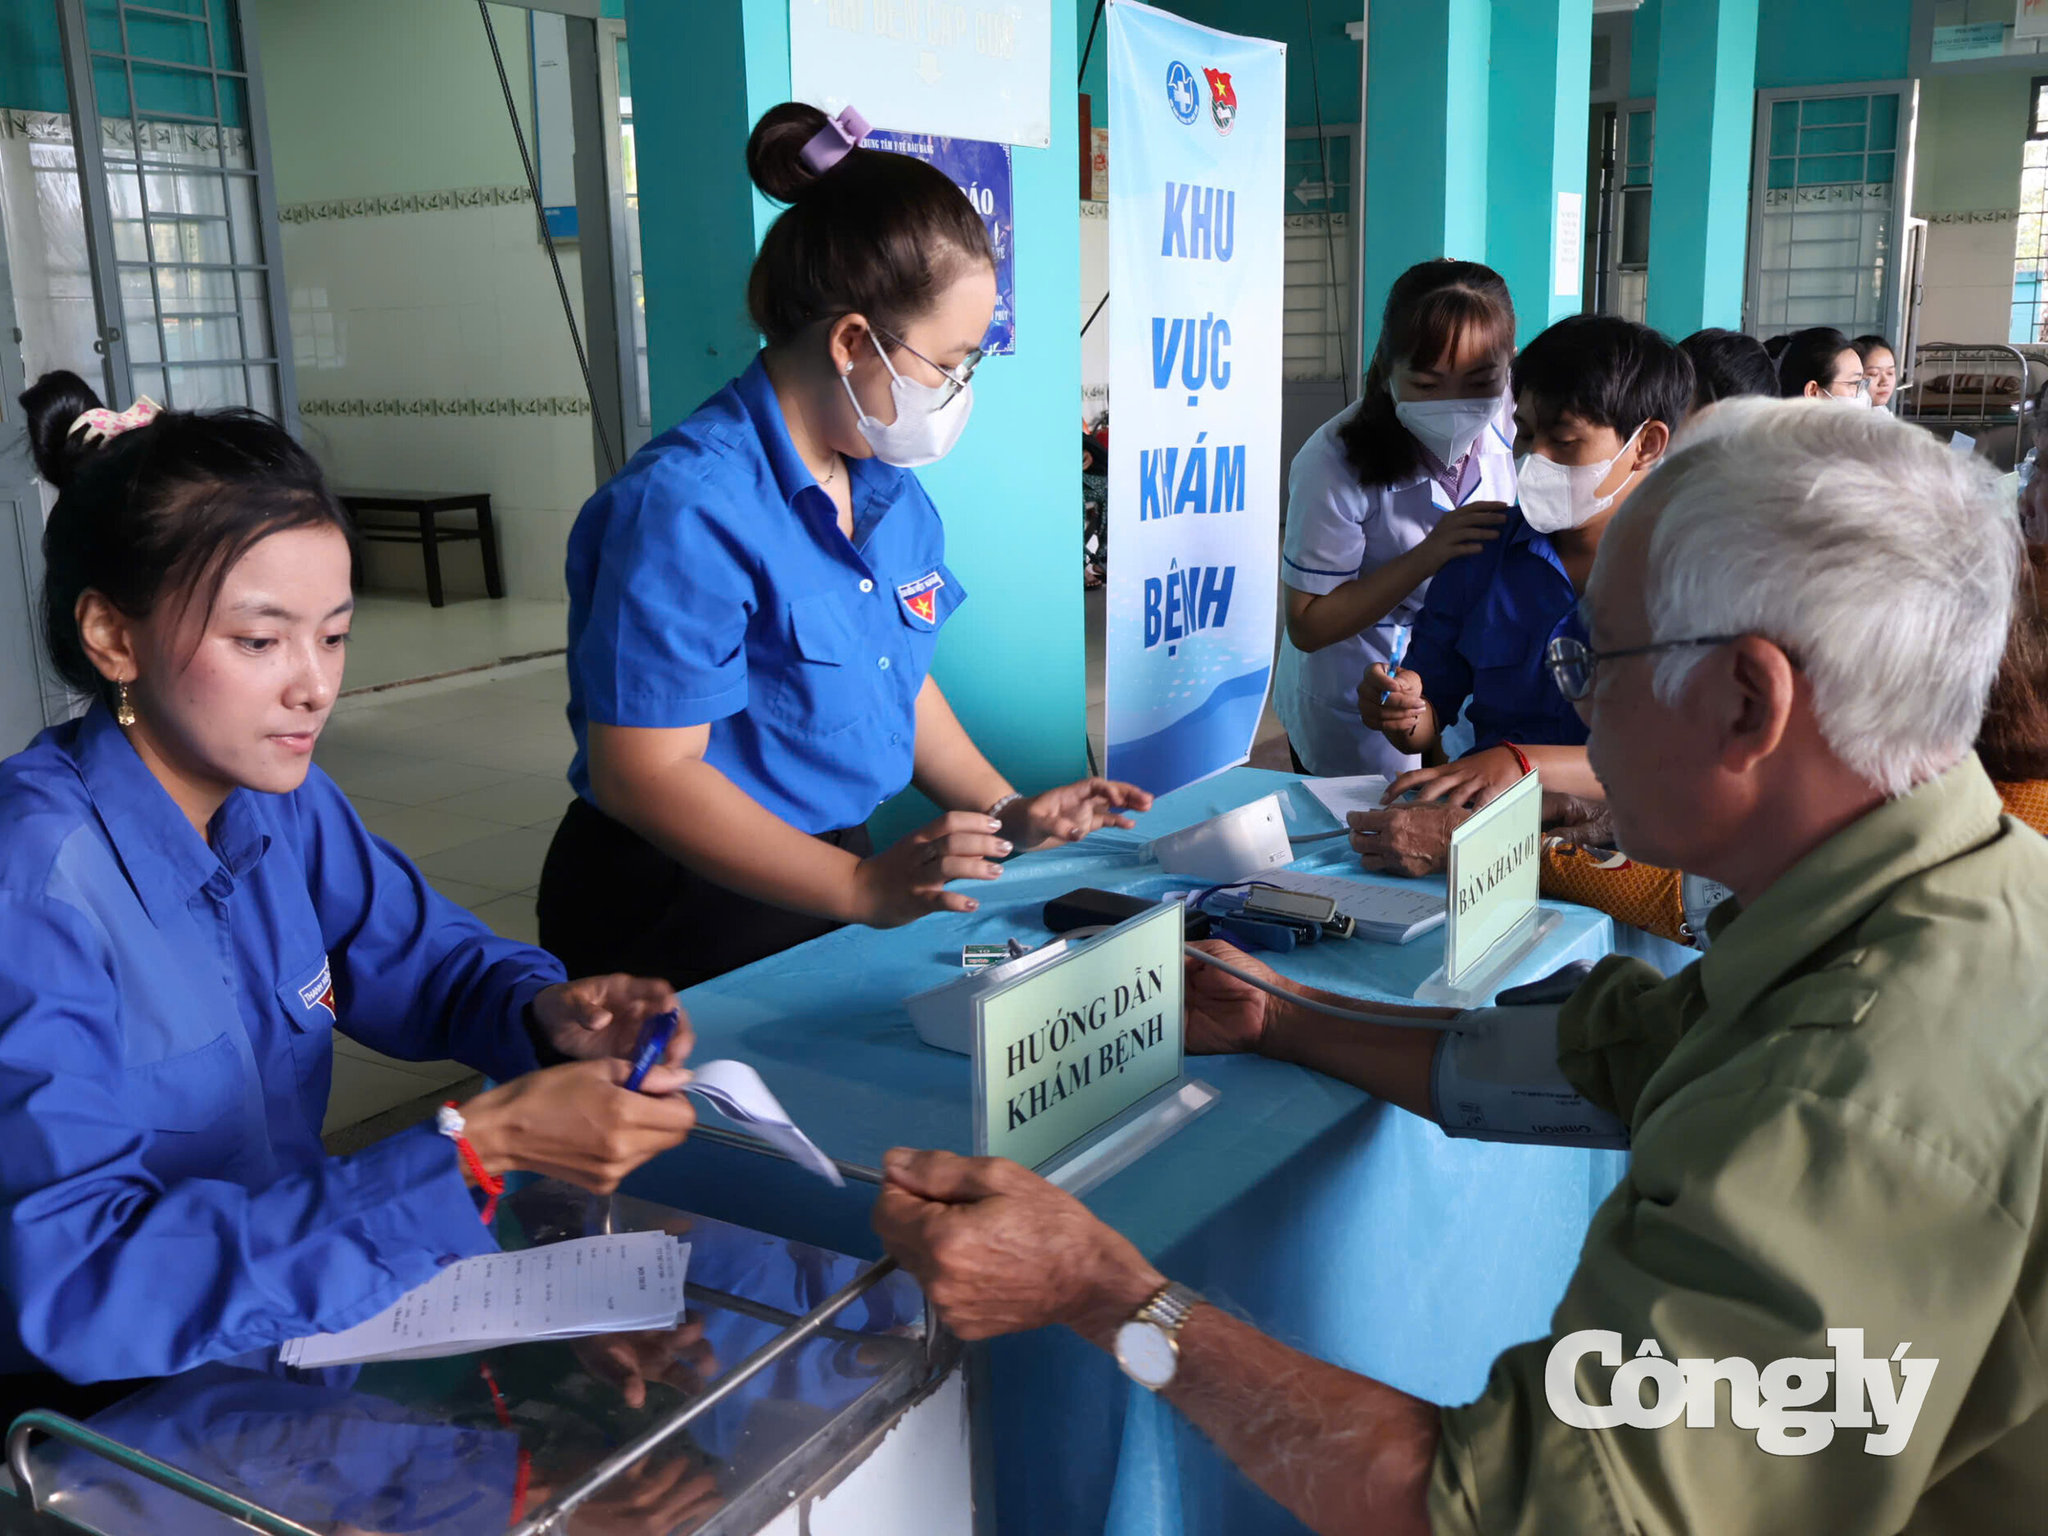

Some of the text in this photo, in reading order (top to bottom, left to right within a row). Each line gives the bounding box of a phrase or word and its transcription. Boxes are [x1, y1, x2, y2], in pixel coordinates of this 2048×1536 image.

[959, 181, 994, 215] ÁO
[1161, 181, 1235, 262] KHU
[1152, 312, 1231, 407] VỰC
[1140, 432, 1246, 522] KHÁM
[1144, 557, 1236, 657] BỆNH
[1487, 842, 1522, 893] KHÁM
[1525, 832, 1535, 860] 01
[1006, 964, 1163, 1079] HƯỚNG DẪN
[1006, 1013, 1164, 1132] KHÁM BỆNH
